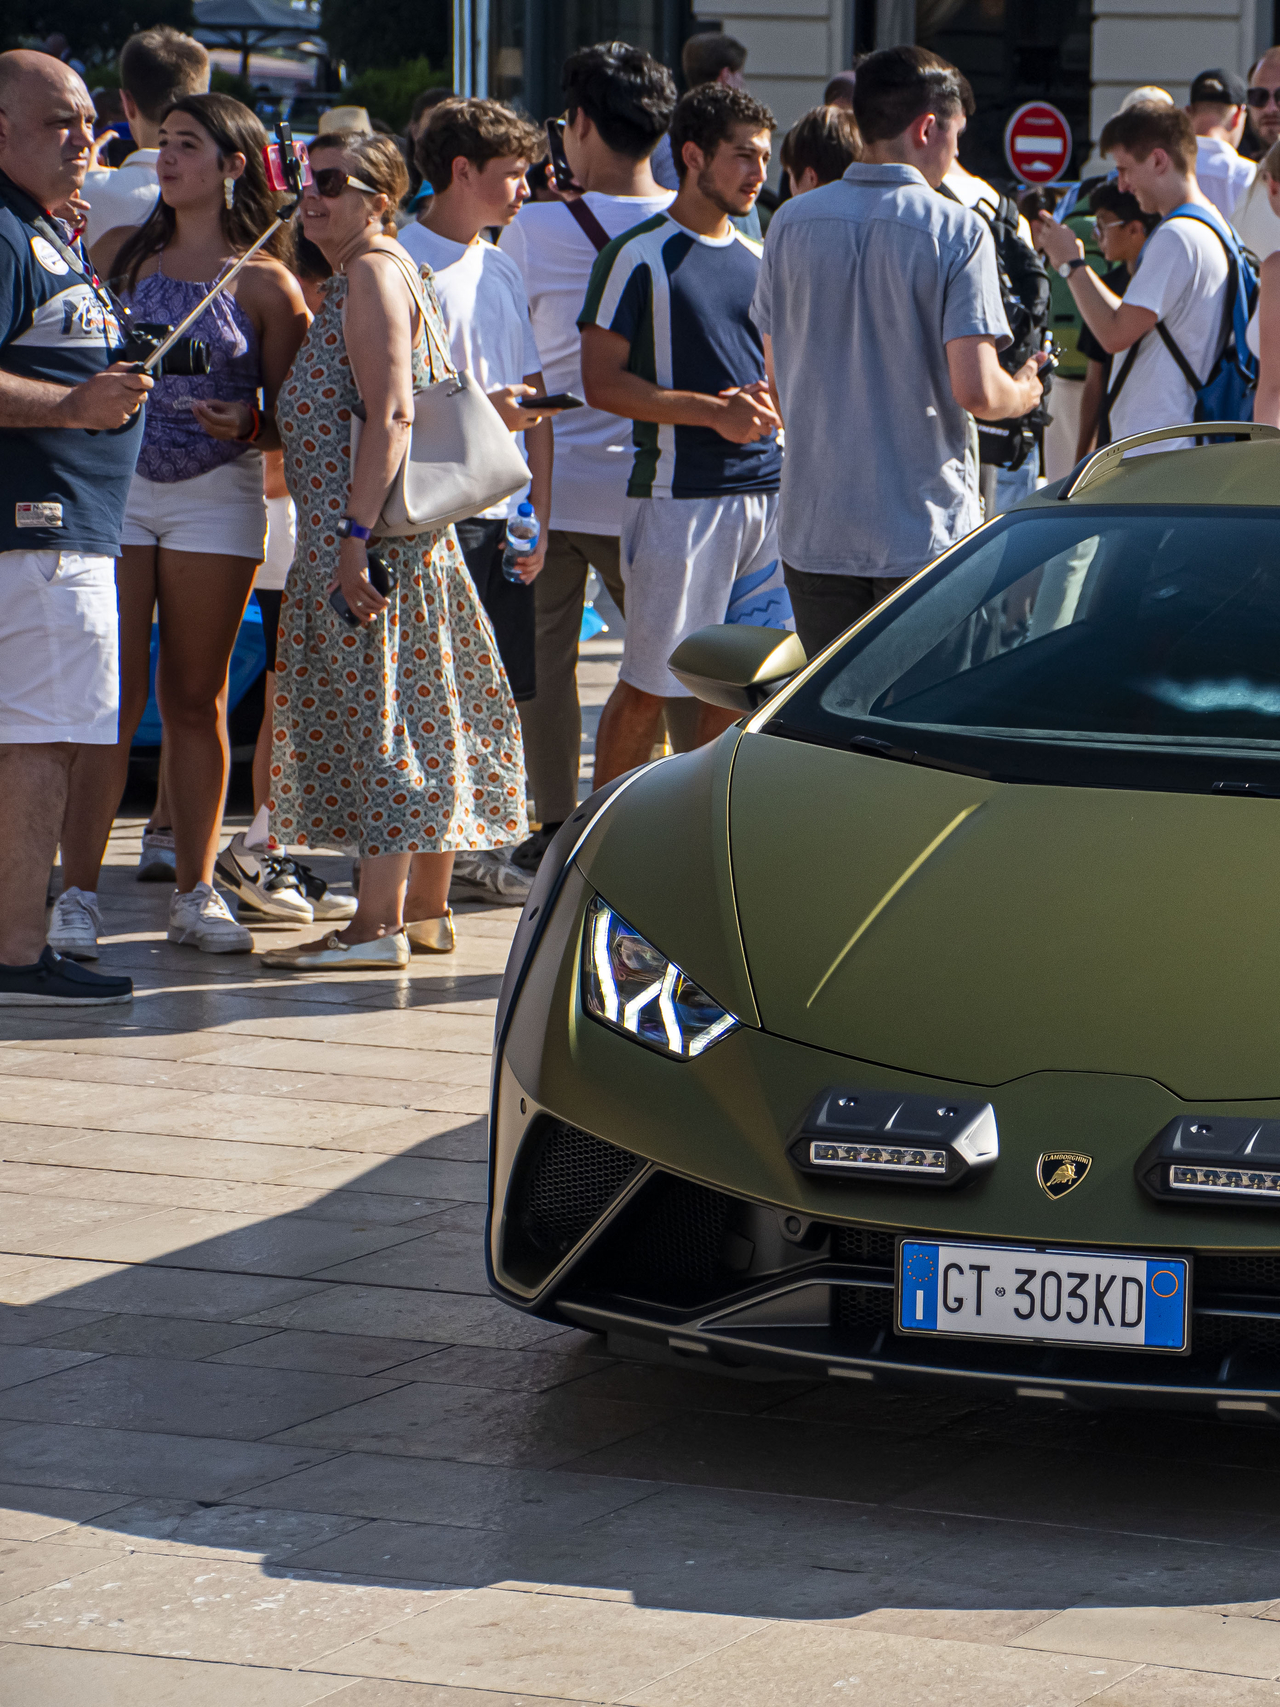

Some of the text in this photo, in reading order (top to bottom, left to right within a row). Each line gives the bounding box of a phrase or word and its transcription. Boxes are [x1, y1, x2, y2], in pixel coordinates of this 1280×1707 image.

[1045, 1154, 1089, 1165] LAMBORGHINI
[915, 1290, 924, 1320] I
[942, 1262, 1144, 1328] GT 303KD
